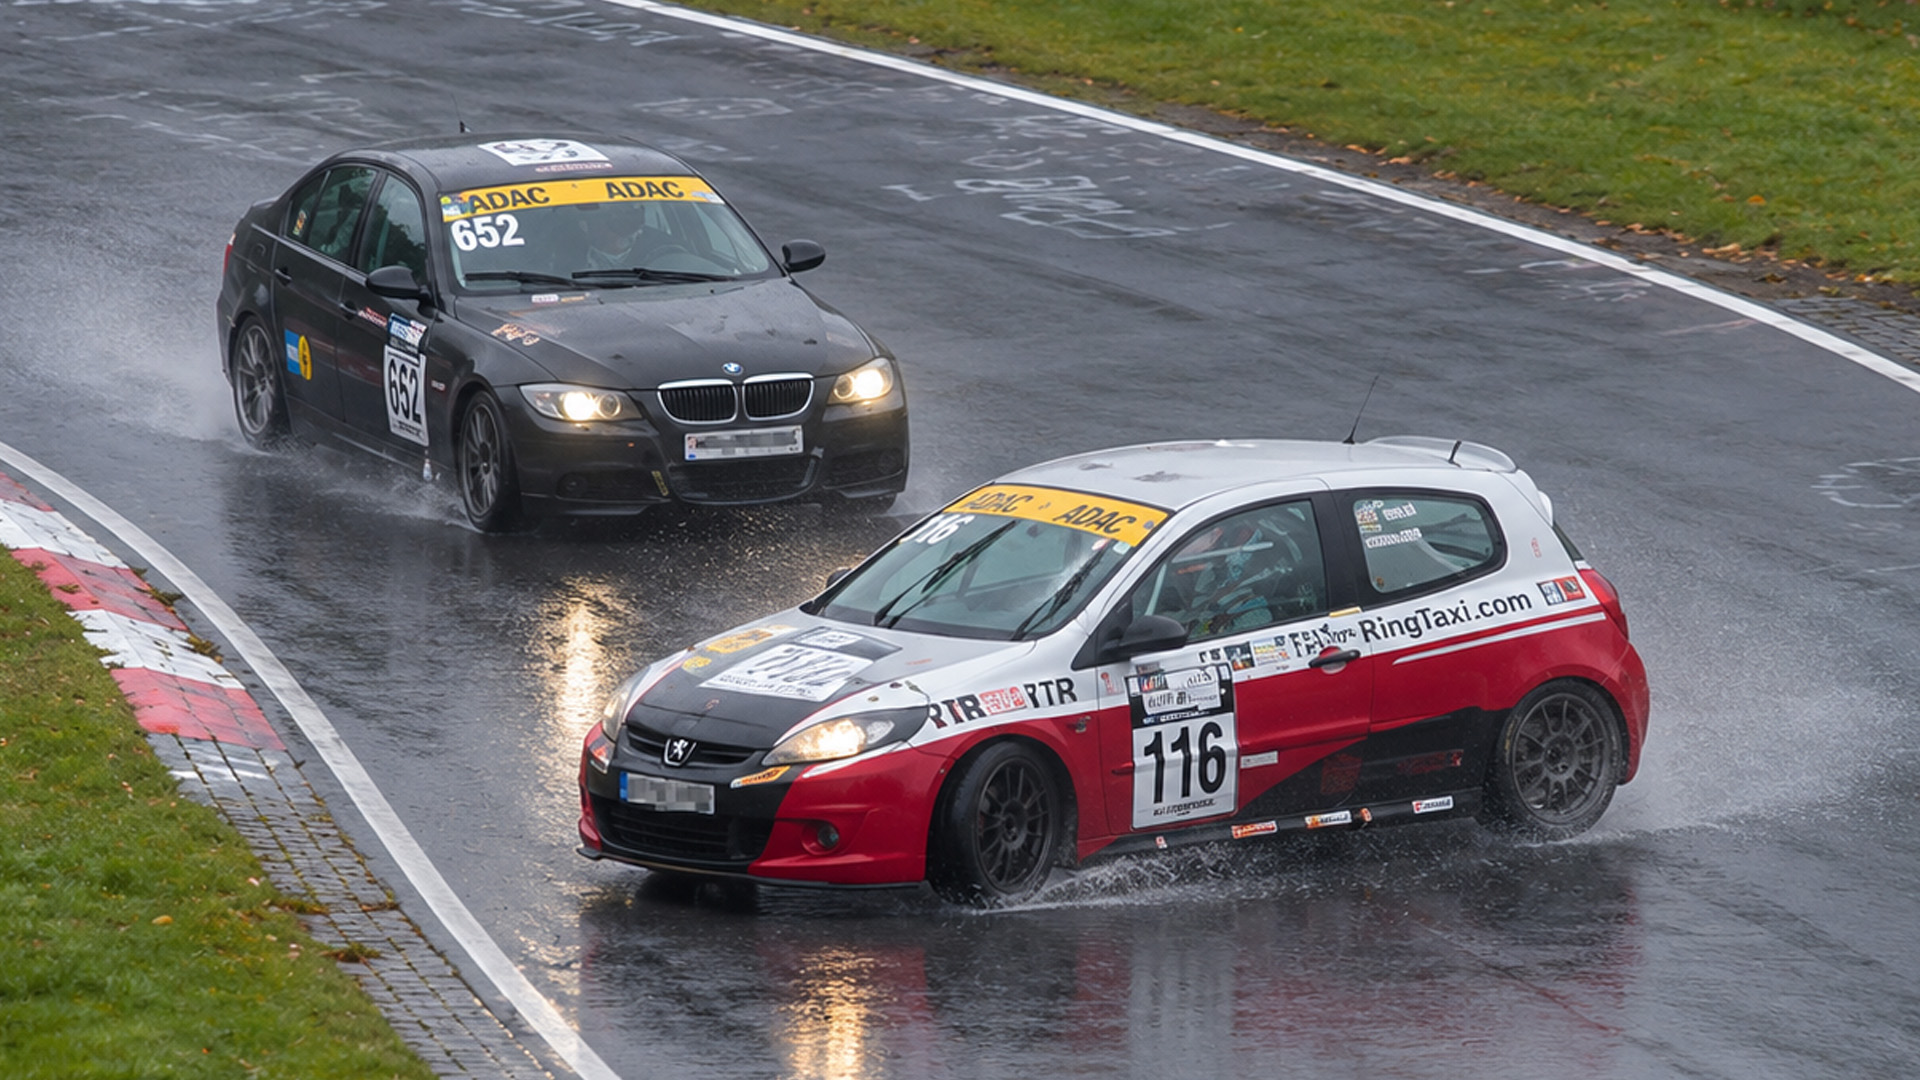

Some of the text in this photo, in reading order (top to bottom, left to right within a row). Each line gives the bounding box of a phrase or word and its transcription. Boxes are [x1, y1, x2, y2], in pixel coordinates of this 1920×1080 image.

[468, 187, 550, 214] ADAC
[605, 181, 685, 199] ADAC
[451, 214, 525, 251] 652
[388, 358, 422, 425] 652
[1052, 504, 1135, 535] ADAC
[1358, 593, 1532, 643] RingTaxi.com
[1144, 721, 1226, 804] 116
